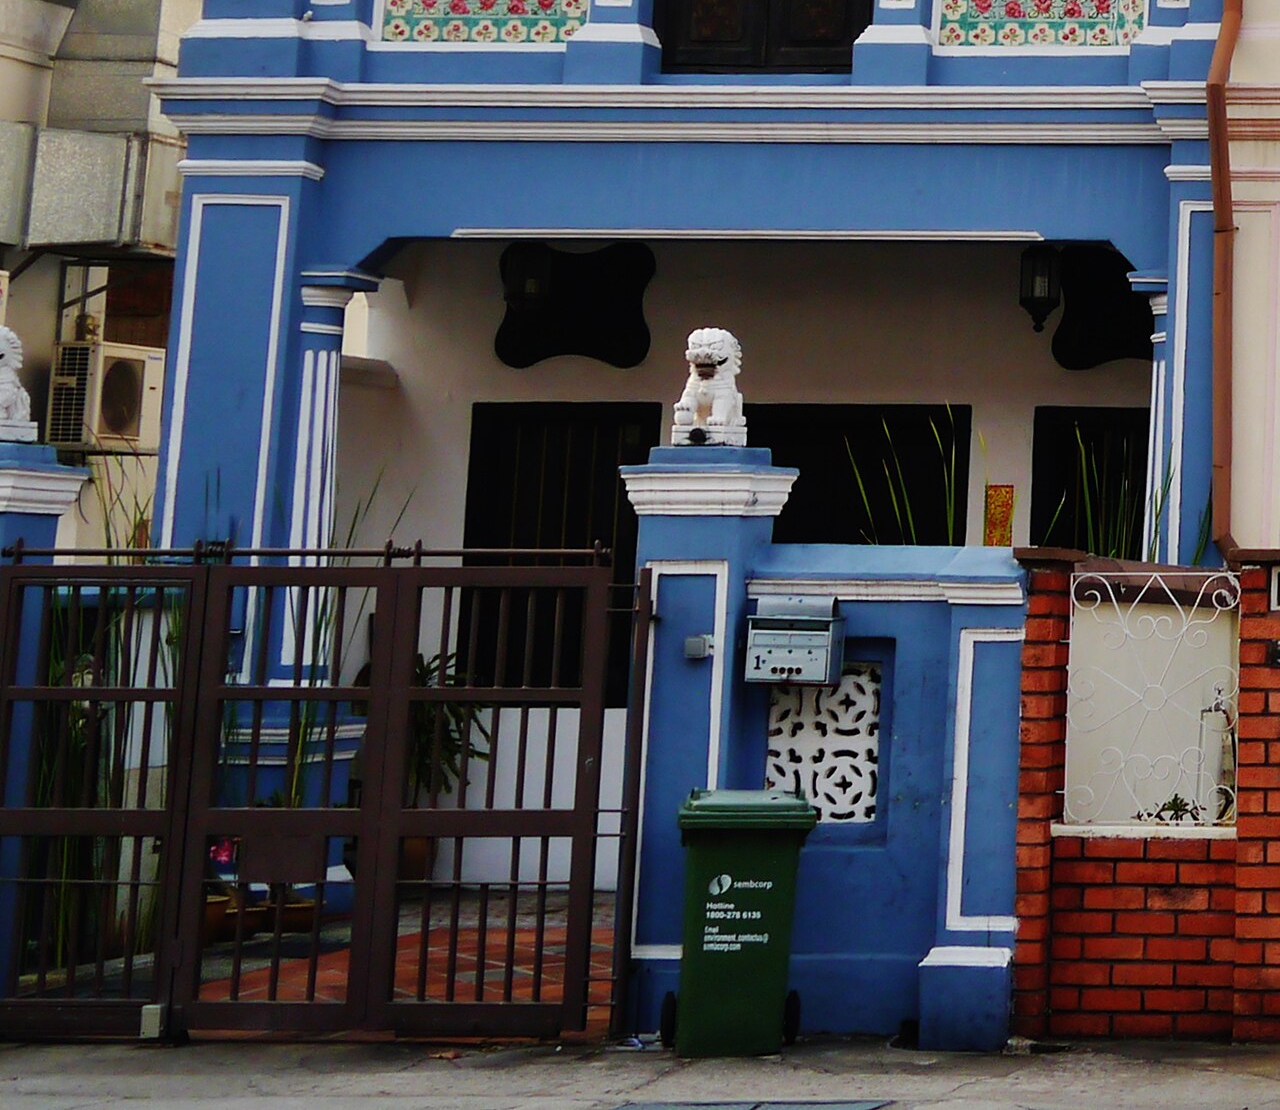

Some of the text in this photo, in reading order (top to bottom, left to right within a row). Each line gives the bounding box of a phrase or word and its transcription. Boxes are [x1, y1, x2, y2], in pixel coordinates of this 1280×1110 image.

[753, 654, 762, 671] 1
[733, 879, 773, 890] sembcorp
[706, 902, 735, 910] Hotline
